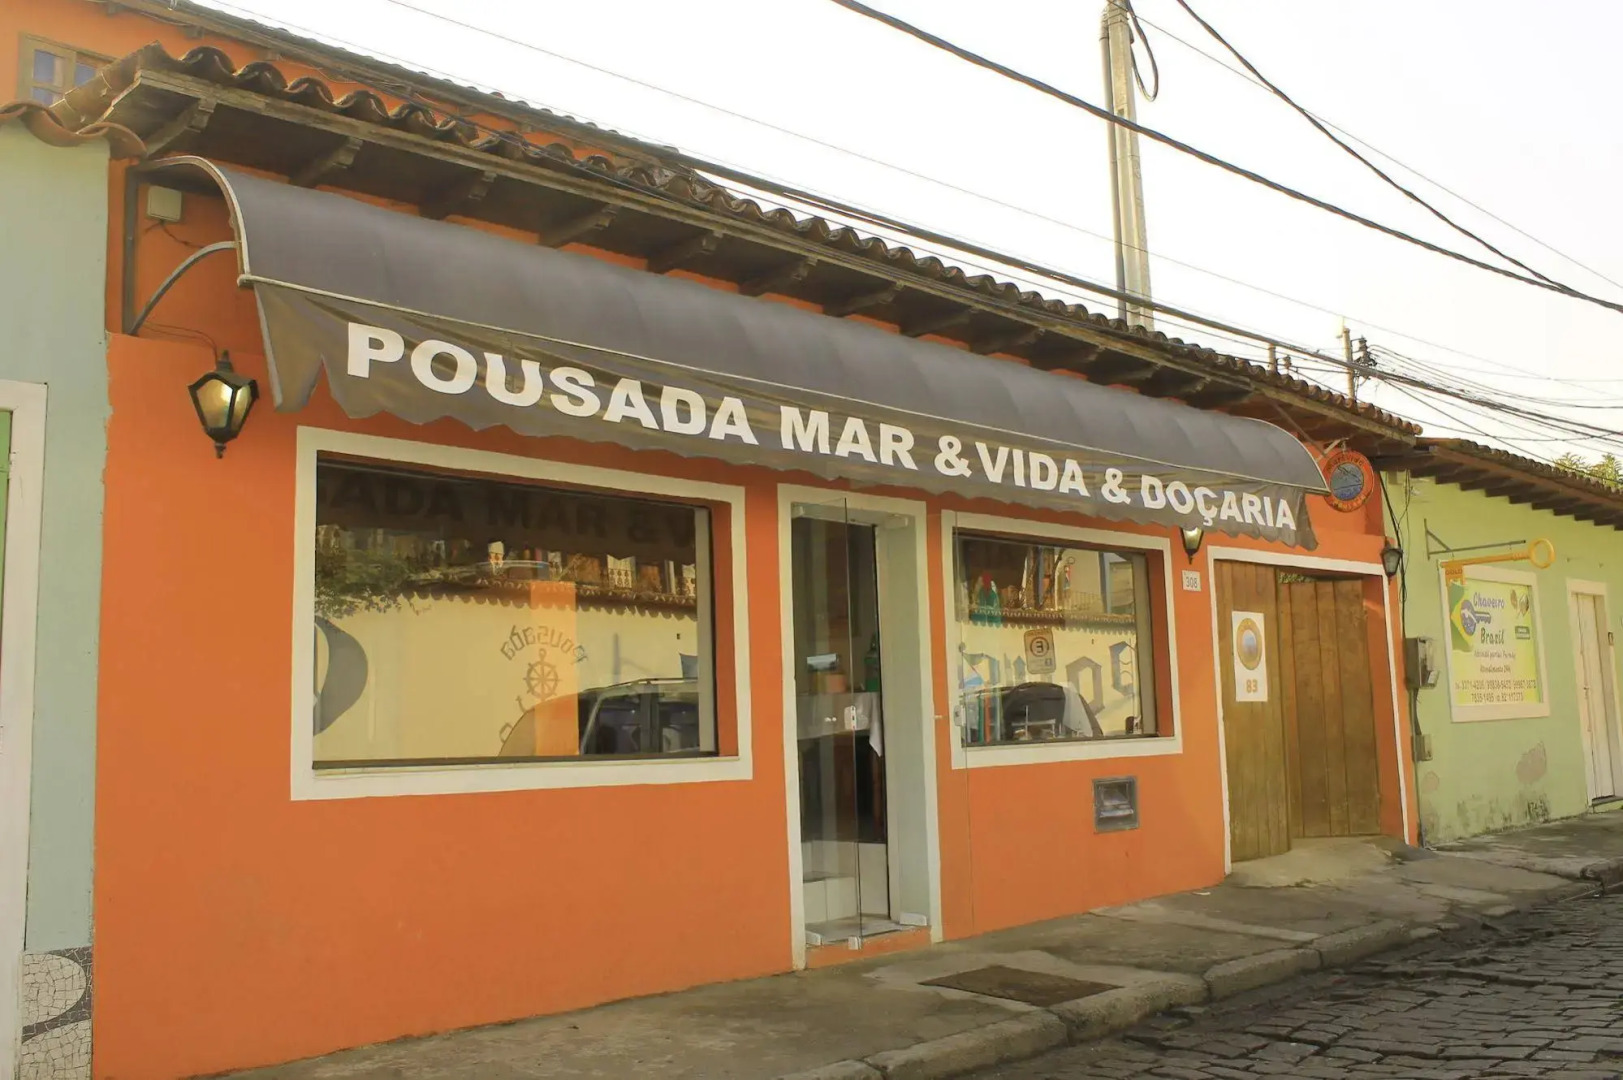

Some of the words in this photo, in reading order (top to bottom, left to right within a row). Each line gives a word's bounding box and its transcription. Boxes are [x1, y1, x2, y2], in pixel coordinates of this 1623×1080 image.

[347, 322, 760, 446] POUSADA
[780, 405, 918, 471] MAR
[934, 434, 973, 478] &
[975, 441, 1091, 497] VIDA
[1100, 467, 1132, 505] &
[1141, 474, 1297, 531] DOÇARIA
[1185, 576, 1198, 588] 308
[1245, 679, 1258, 693] 83
